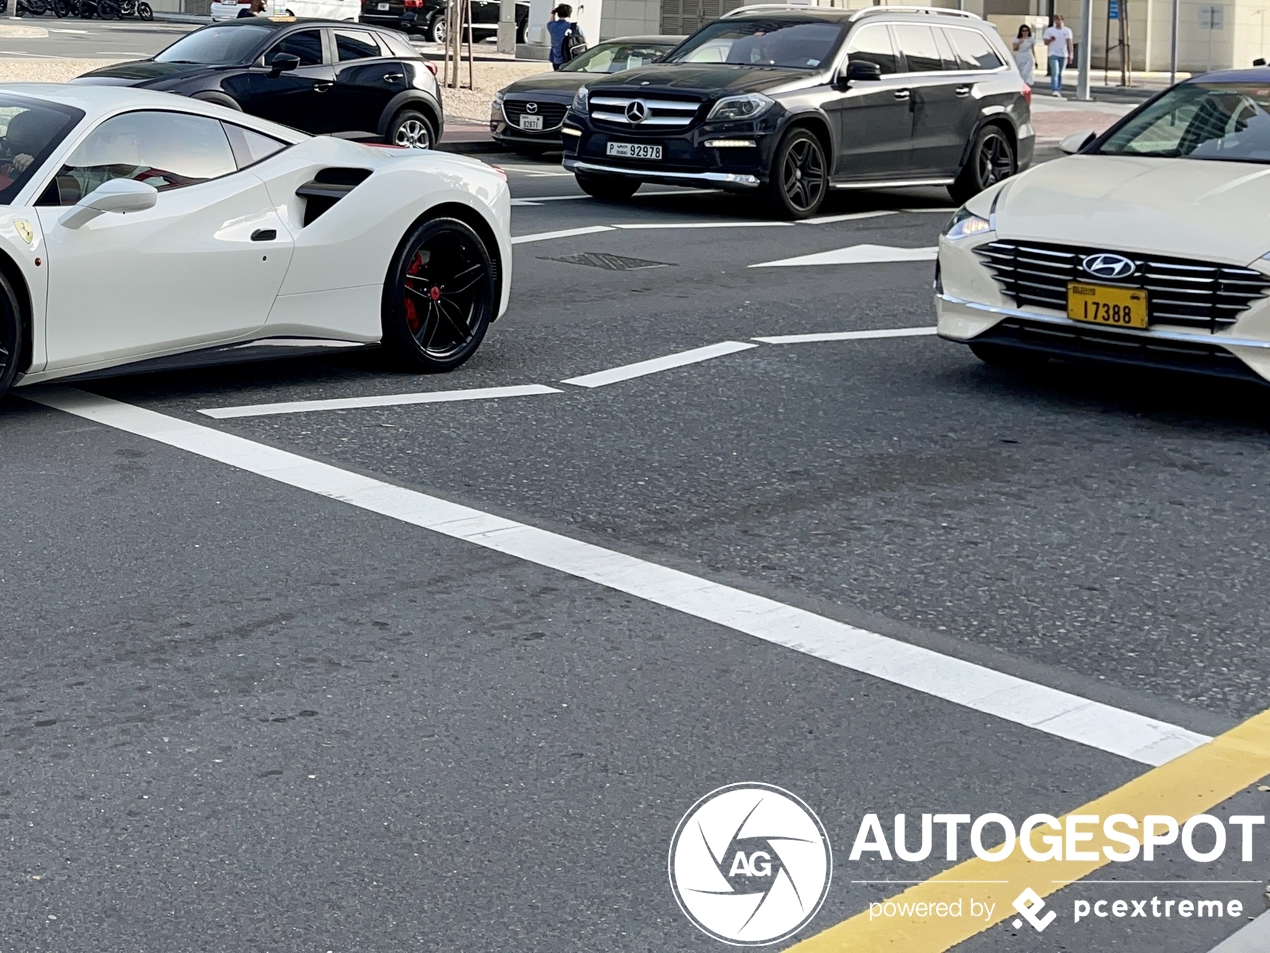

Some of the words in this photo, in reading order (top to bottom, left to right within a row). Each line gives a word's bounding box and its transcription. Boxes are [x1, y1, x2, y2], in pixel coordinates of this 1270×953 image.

[610, 144, 614, 153] P
[630, 145, 661, 158] 92978
[1084, 300, 1132, 324] 17388
